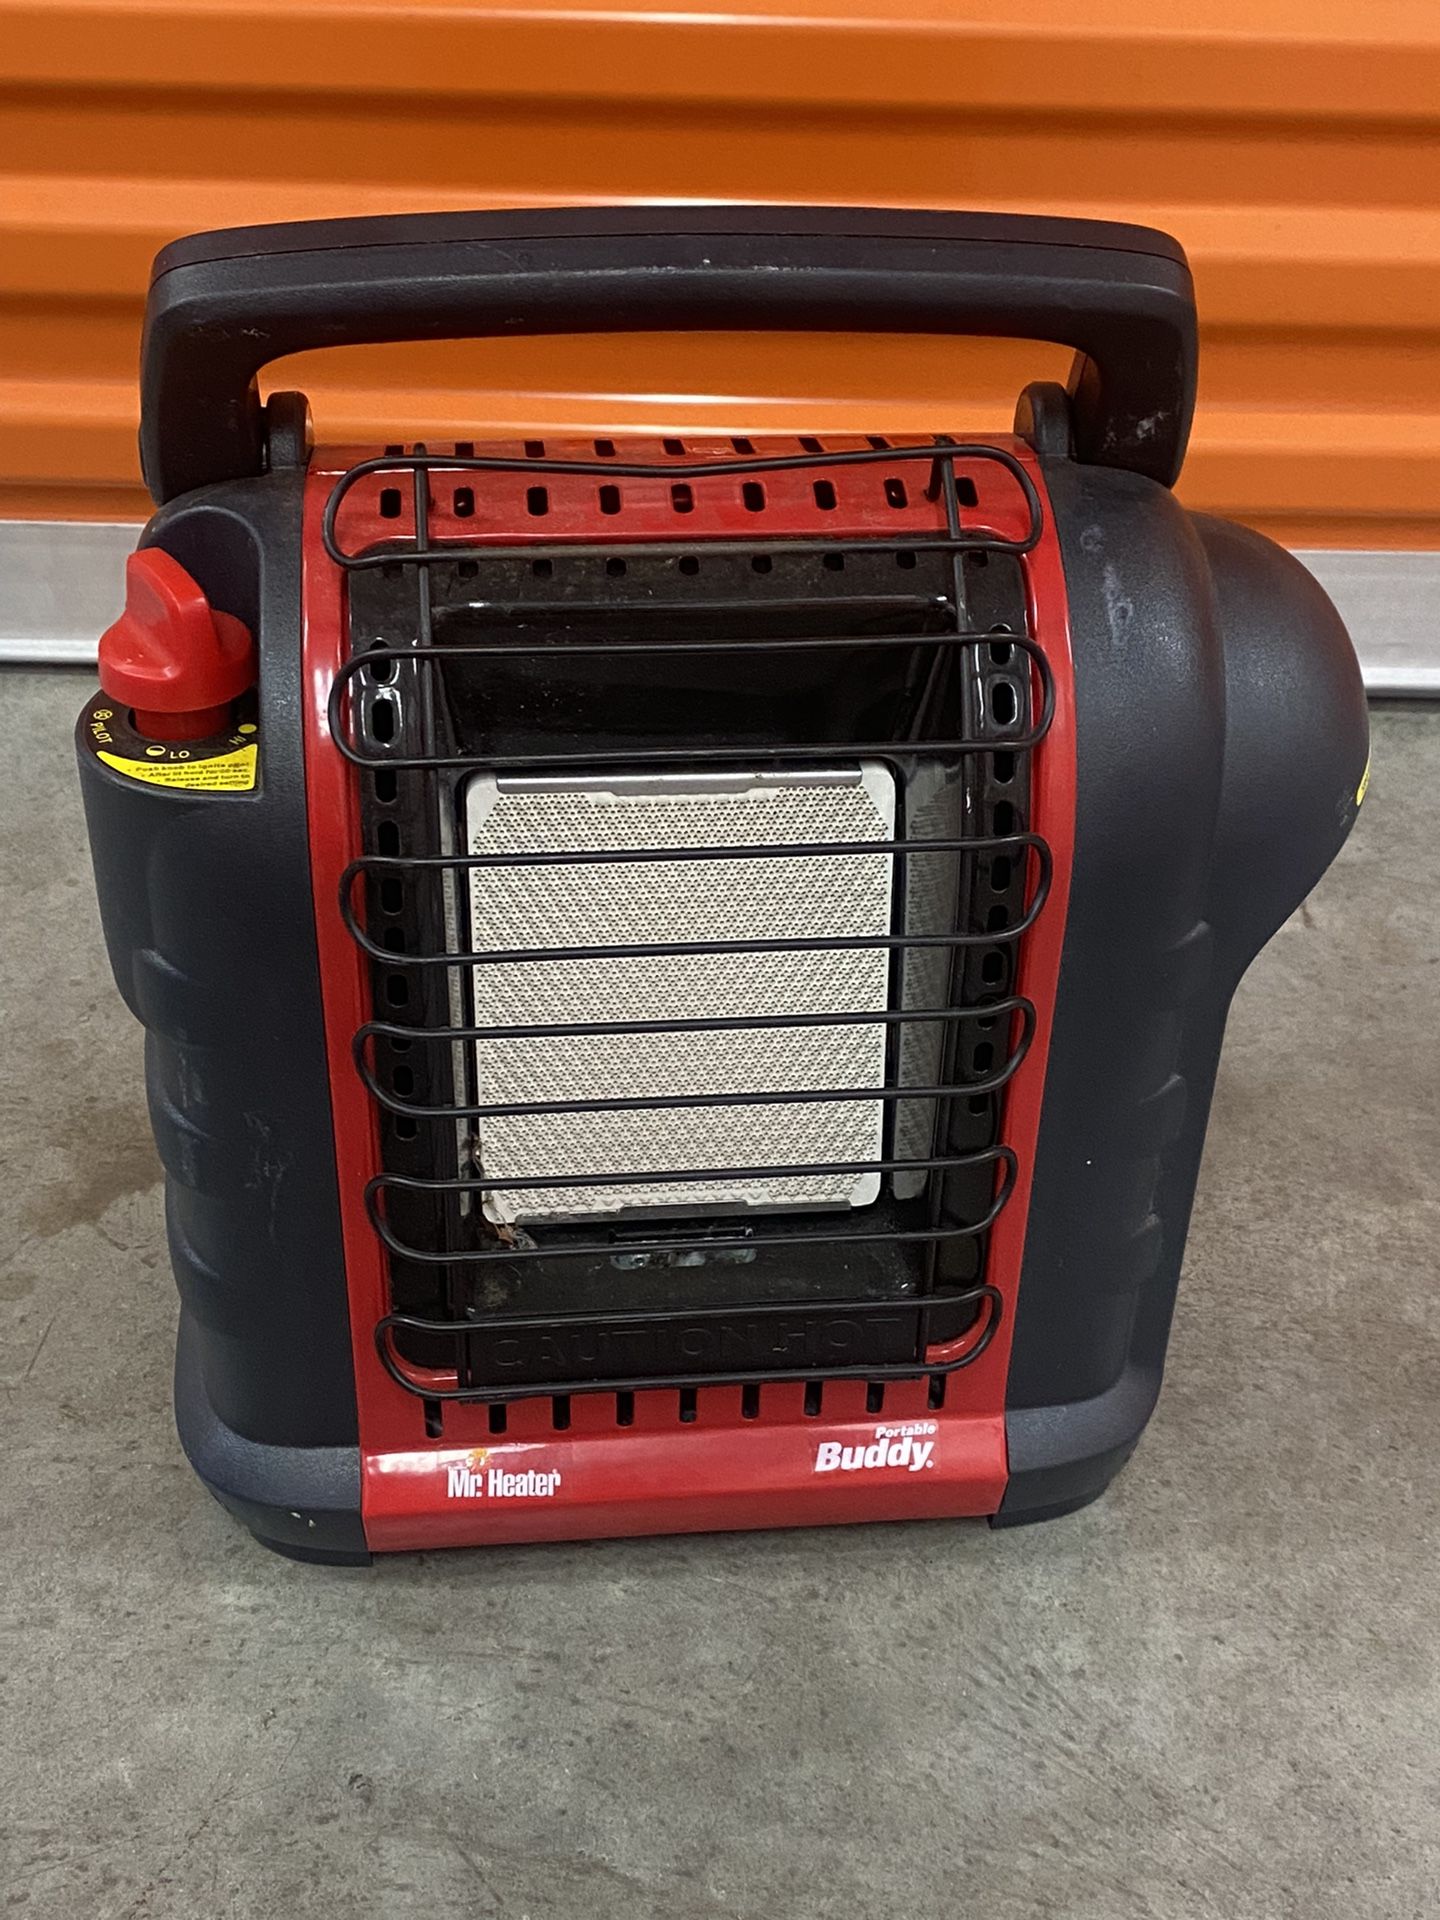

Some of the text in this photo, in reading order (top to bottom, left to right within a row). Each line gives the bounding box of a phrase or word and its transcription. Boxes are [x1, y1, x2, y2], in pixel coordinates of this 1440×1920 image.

[90, 721, 113, 743] PILOT
[169, 750, 190, 759] LO
[496, 1318, 902, 1367] CAUTION HOT
[875, 1423, 937, 1439] Portable
[447, 1467, 561, 1498] Mr. Heater
